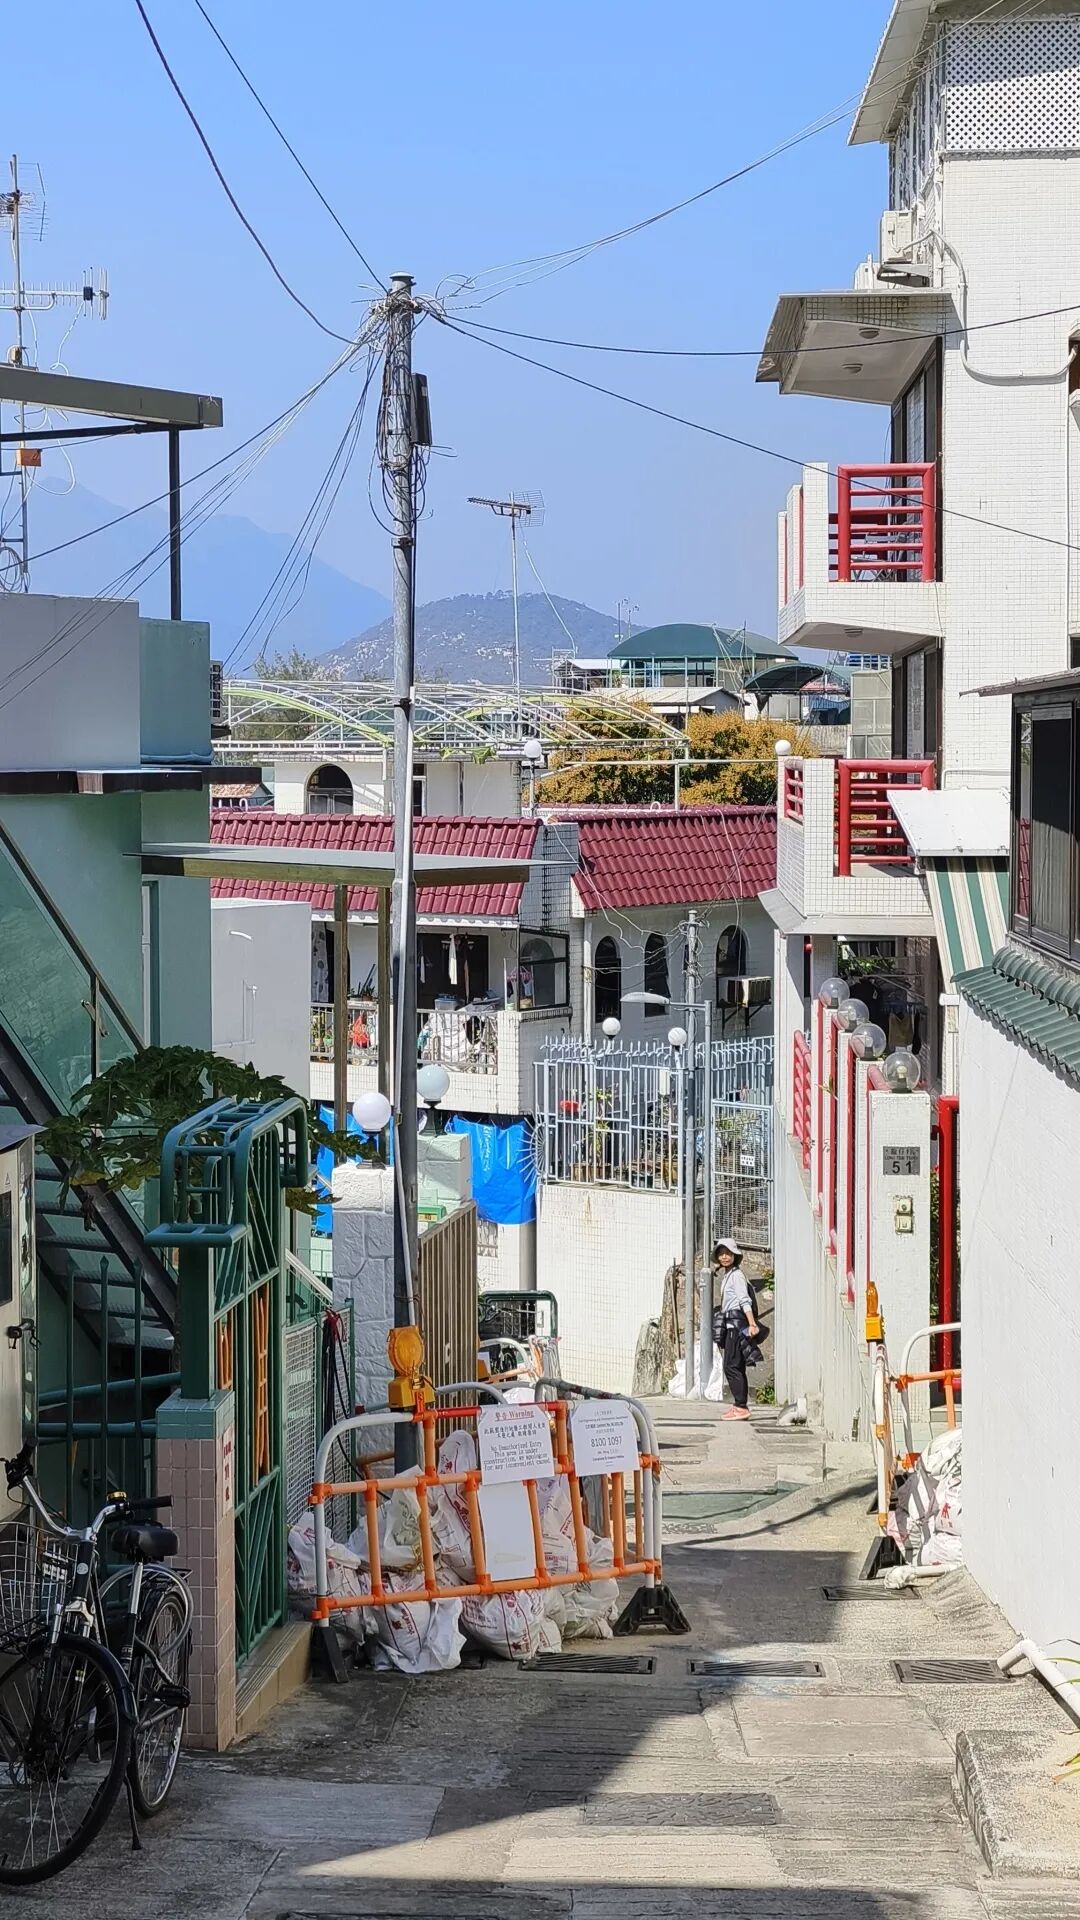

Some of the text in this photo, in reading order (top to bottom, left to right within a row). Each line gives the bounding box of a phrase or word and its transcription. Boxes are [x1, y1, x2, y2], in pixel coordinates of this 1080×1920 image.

[892, 1161, 911, 1174] 51
[509, 1410, 534, 1418] Warning
[590, 1436, 622, 1447] 8100 1097
